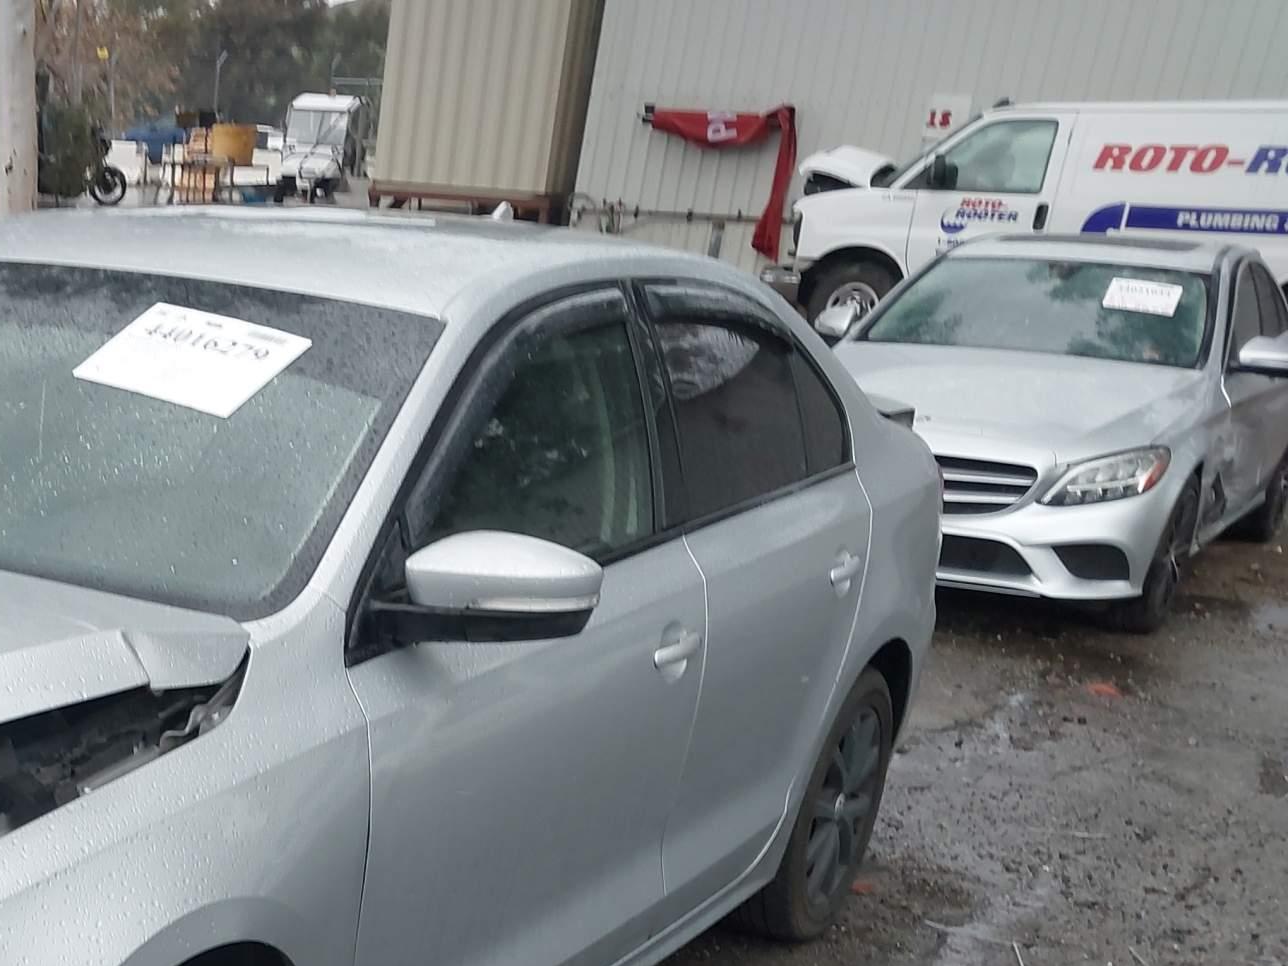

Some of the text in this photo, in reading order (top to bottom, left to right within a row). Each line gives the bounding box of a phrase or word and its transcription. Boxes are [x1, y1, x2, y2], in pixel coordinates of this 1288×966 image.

[1092, 143, 1288, 174] ROTO-R
[955, 207, 1019, 222] ROOTER
[1176, 210, 1280, 232] PLUMBING
[144, 322, 270, 361] 44016279
